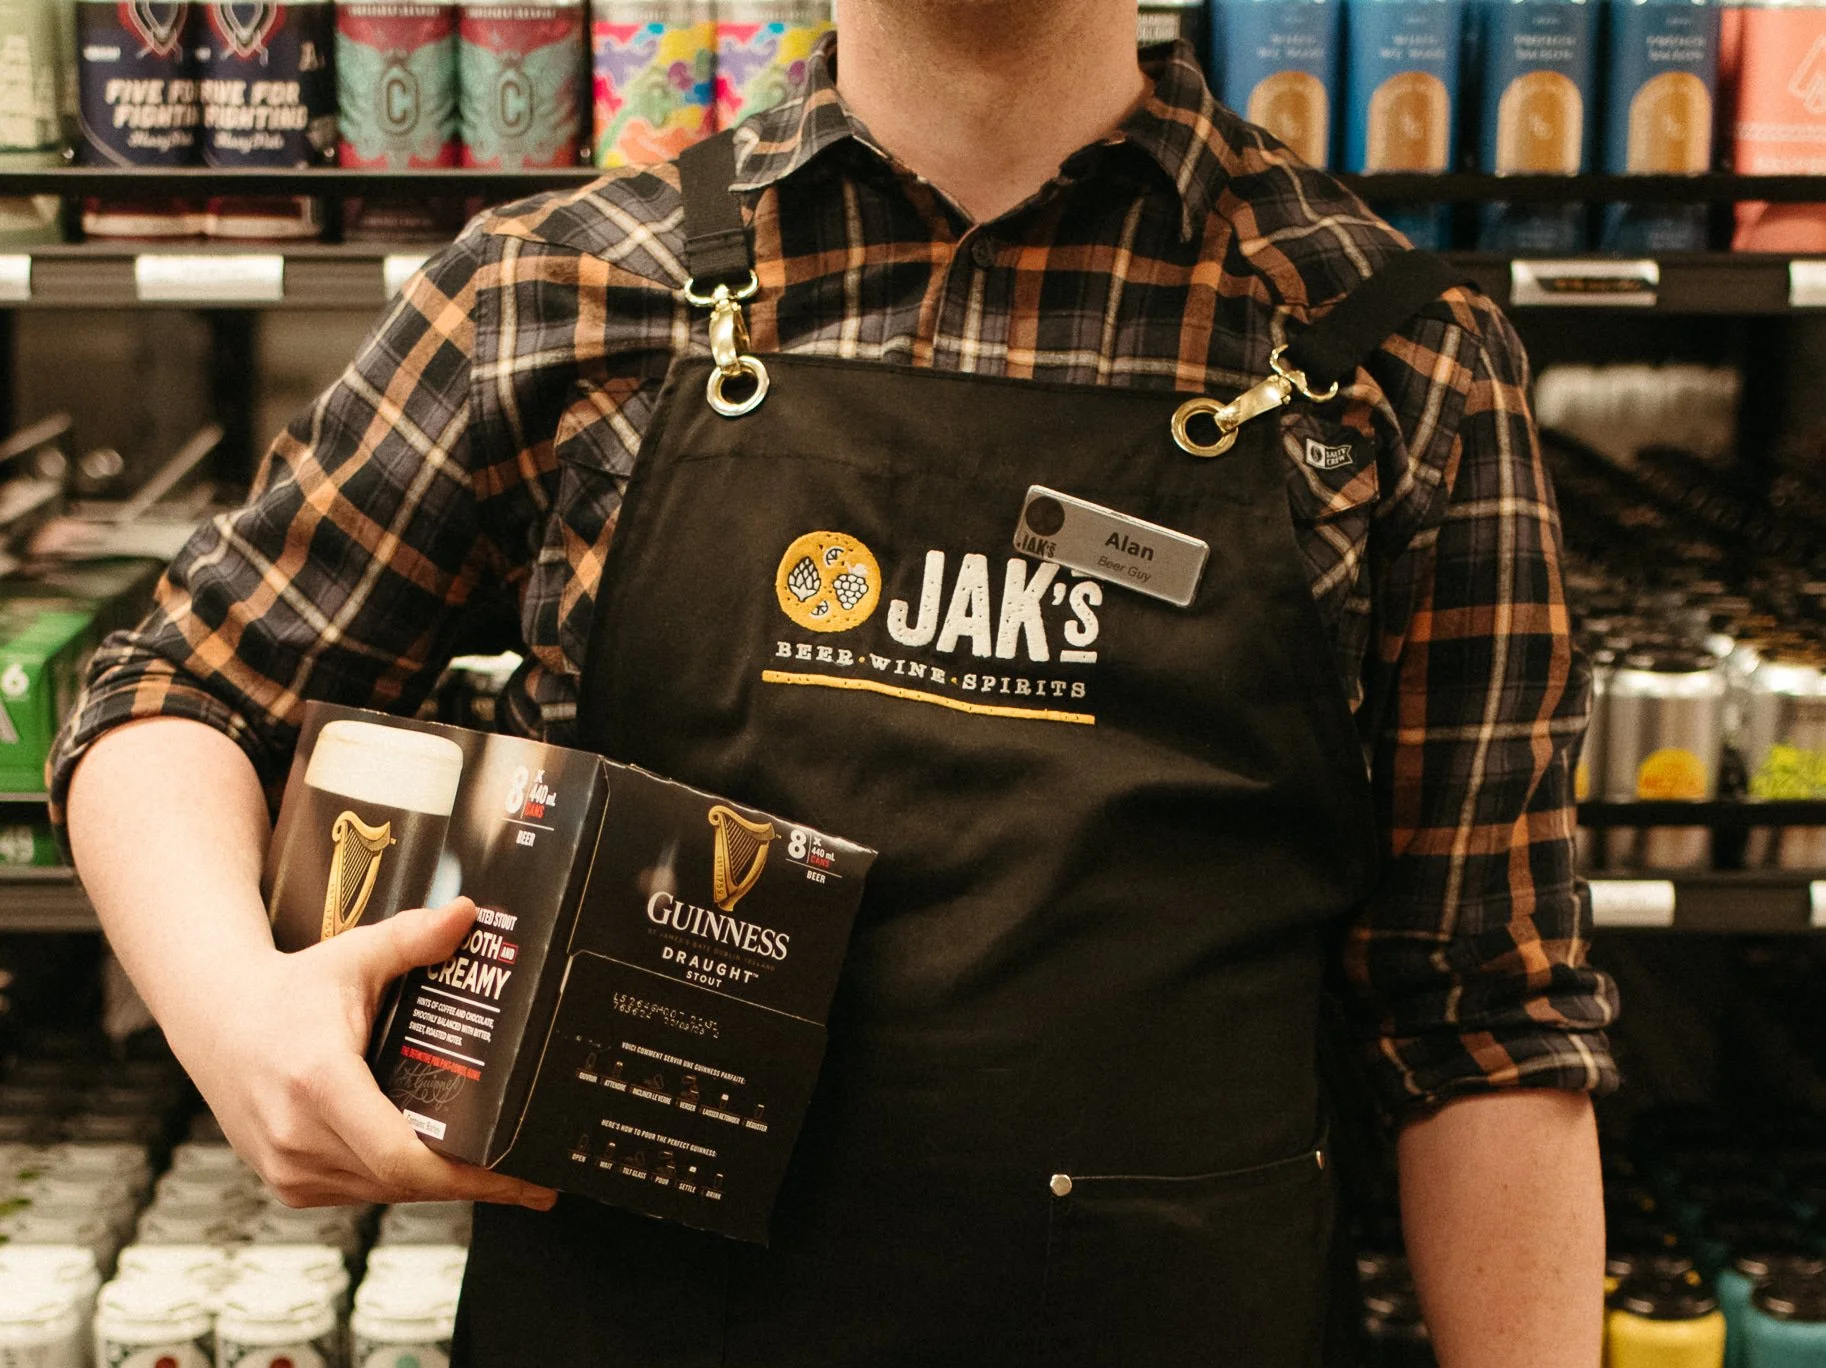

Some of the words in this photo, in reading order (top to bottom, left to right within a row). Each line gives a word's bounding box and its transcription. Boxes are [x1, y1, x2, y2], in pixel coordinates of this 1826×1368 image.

[105, 78, 165, 104] FIVE
[250, 80, 300, 106] FOR
[204, 104, 308, 130] FIGHTING
[1105, 531, 1154, 561] Alan
[1097, 555, 1125, 573] Beer
[1128, 566, 1152, 584] Guy
[775, 641, 854, 667] BEER
[869, 652, 946, 684] WINE
[962, 675, 1087, 699] SPIRITS
[505, 765, 529, 814] 8
[529, 783, 548, 804] 440
[523, 801, 545, 819] CANS
[516, 830, 536, 847] BEER
[788, 829, 807, 859] 8
[811, 855, 830, 868] CANS
[812, 847, 825, 858] 440
[716, 871, 724, 895] 1759
[807, 870, 826, 884] BEER
[494, 911, 518, 931] STOUT
[647, 891, 790, 961] GUINNESS
[500, 947, 515, 961] AND
[686, 970, 722, 988] STOUT
[417, 996, 432, 1008] HINTS
[431, 1000, 439, 1009] OF
[439, 1003, 456, 1015] COFFEE
[456, 1008, 466, 1018] AND
[409, 1021, 425, 1035] SWEET,
[426, 1025, 447, 1040] ROASTED
[413, 1009, 438, 1023] SMOOTHLY
[437, 1017, 461, 1031] BALANCED
[461, 1024, 474, 1036] WITH
[622, 1041, 636, 1052] VOICI
[637, 1046, 663, 1061] COMMENT
[664, 1054, 682, 1065] SERVIR
[683, 1060, 693, 1070] UNE
[694, 1063, 721, 1078] GUINNESS
[579, 1072, 598, 1083] OUVRIR
[604, 1079, 627, 1092] ATTENDRE
[679, 1102, 697, 1112] VERSER
[601, 1119, 620, 1130] HERE'S
[620, 1123, 633, 1134] HOW
[634, 1128, 642, 1137] TO
[641, 1130, 656, 1140] POUR
[656, 1134, 667, 1143] THE
[667, 1137, 690, 1150] PERFECT
[571, 1153, 587, 1163] OPEN
[600, 1161, 613, 1170] WAIT
[623, 1167, 632, 1176] TILT
[632, 1170, 647, 1180] GLASS
[655, 1176, 669, 1186] POUR
[679, 1183, 697, 1194] SETTLE
[705, 1190, 722, 1200] DRINK
